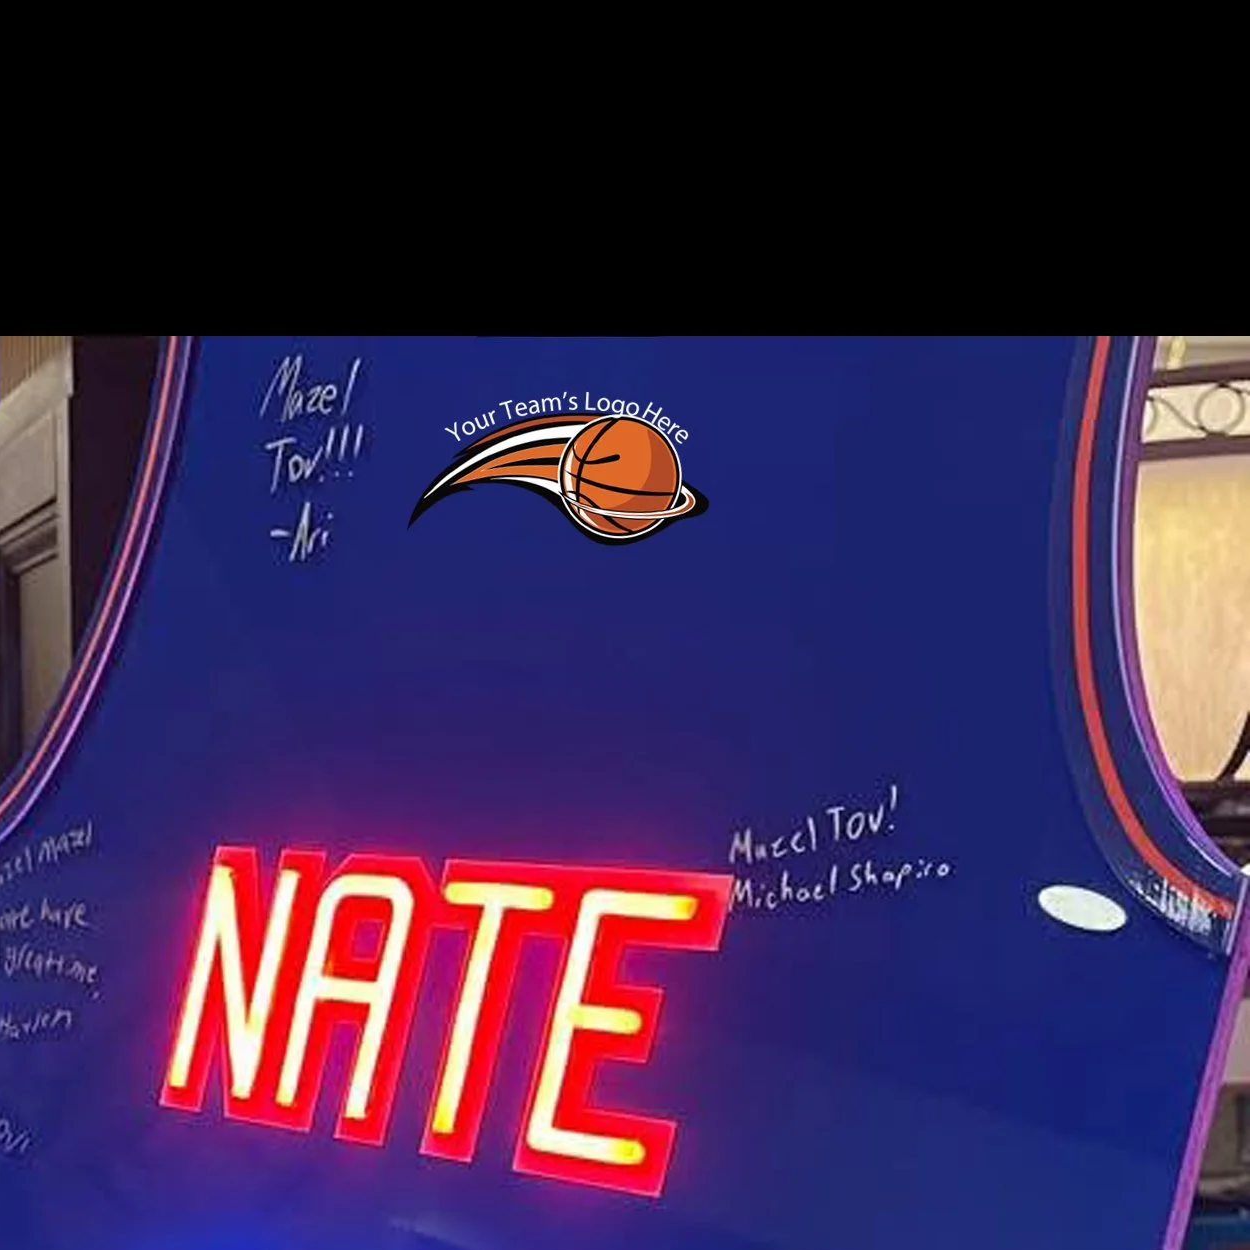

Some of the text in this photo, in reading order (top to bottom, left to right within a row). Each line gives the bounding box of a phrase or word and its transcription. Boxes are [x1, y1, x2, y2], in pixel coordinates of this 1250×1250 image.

[259, 354, 362, 424] Mazel
[264, 423, 364, 495] Tov!!!
[728, 858, 952, 912] Michael Shapiro
[160, 846, 734, 1198] NATE
